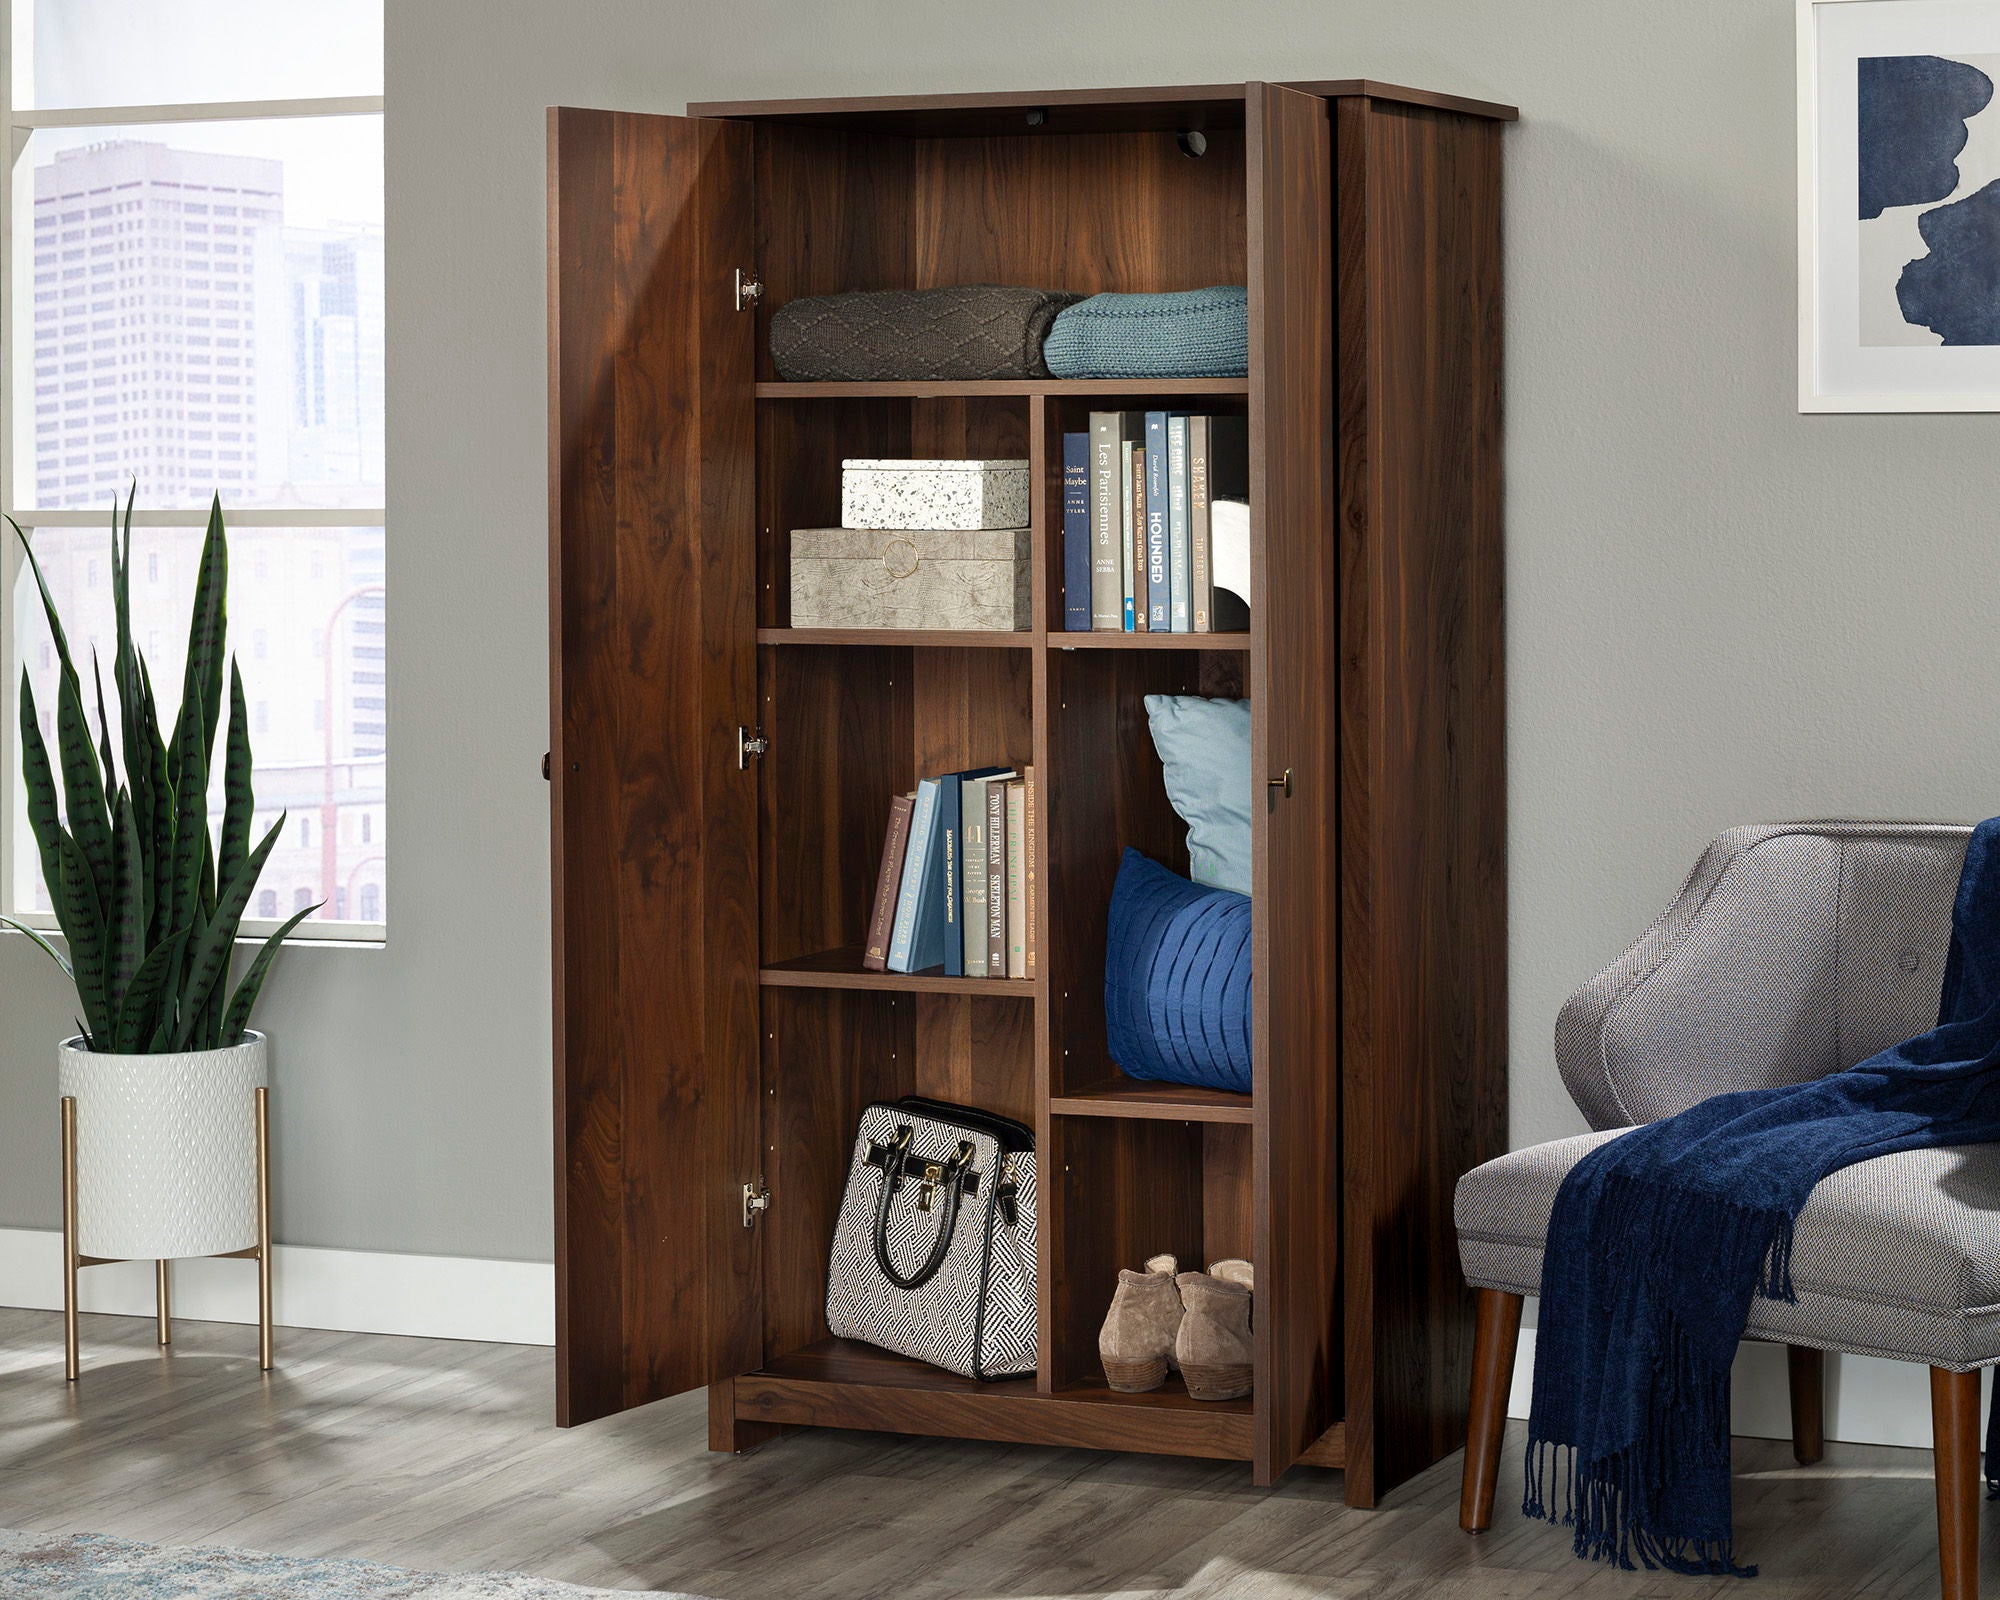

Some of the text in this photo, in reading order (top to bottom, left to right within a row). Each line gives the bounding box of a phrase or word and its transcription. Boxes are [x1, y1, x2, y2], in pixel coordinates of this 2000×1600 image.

[1065, 477, 1087, 487] Maybe
[1066, 465, 1084, 473] Saint
[1099, 443, 1112, 545] Les Parisiennes
[1192, 457, 1205, 510] SHAKEN
[1150, 512, 1163, 584] HOUNDED
[1027, 781, 1035, 808] INSIDE
[966, 825, 984, 844] 41
[989, 793, 1000, 865] TONY HILLERMAN
[990, 874, 1001, 938] SKELETON MAN
